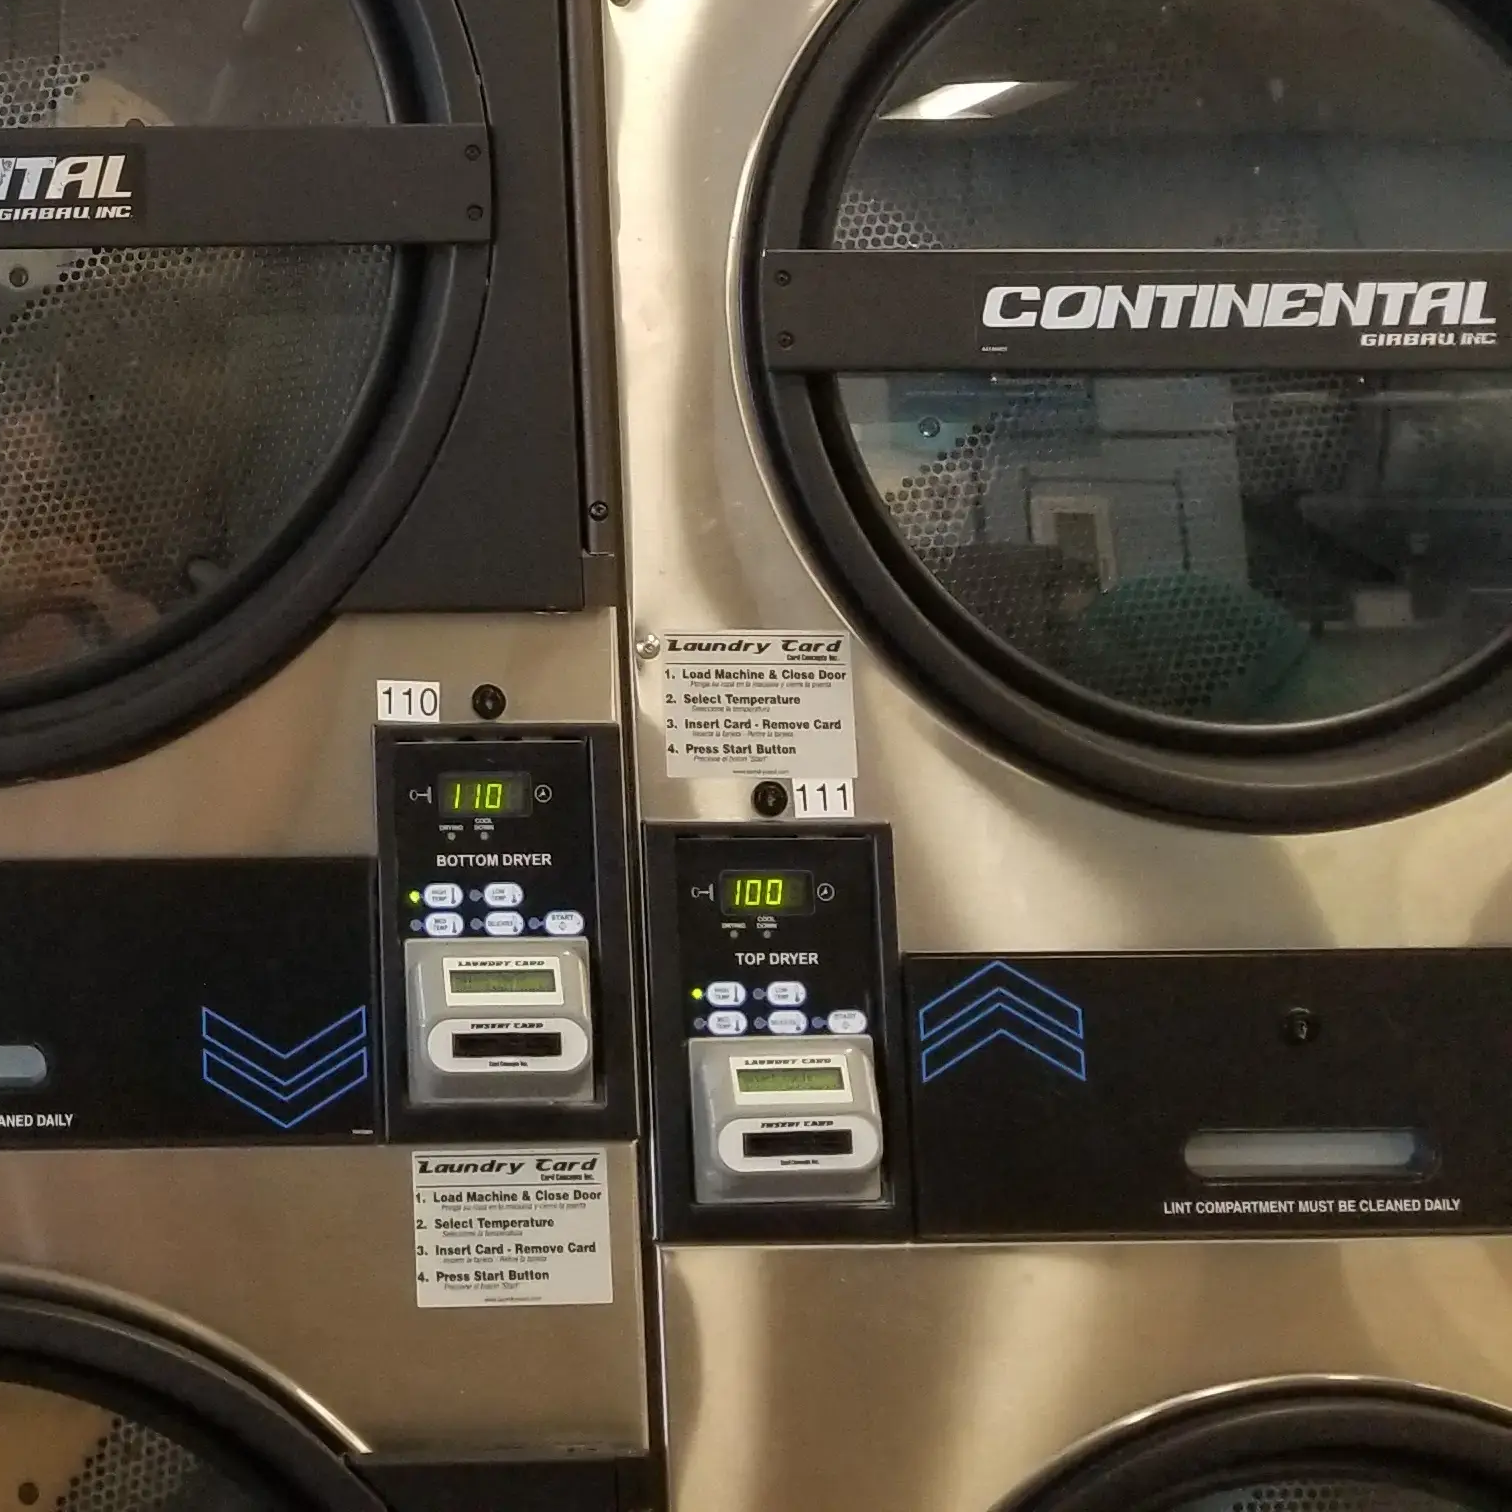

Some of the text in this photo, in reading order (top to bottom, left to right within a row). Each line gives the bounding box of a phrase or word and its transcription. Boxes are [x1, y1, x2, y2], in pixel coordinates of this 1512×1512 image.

[982, 281, 1496, 329] CONTINENTAL
[668, 639, 841, 654] Laundry Card
[682, 670, 711, 679] Load
[715, 670, 764, 679] Machine
[769, 670, 777, 679] &
[782, 670, 814, 679] Close
[819, 670, 846, 680] Door
[383, 686, 438, 716] 110
[684, 694, 721, 704] Select
[725, 694, 800, 705] Temperature
[685, 719, 719, 729] Insert
[724, 719, 751, 729] Card
[763, 720, 809, 729] Remove
[814, 720, 841, 729] Card
[686, 744, 719, 754] Press
[723, 744, 752, 754] Start
[757, 744, 796, 754] Button
[454, 784, 502, 809] 110
[796, 783, 847, 811] 111
[437, 854, 552, 866] BOTTOM DRYER
[735, 879, 783, 905] 100
[735, 952, 819, 965] TOP DRYER
[37, 1114, 74, 1127] DAILY
[418, 1158, 597, 1175] Laundry Card
[433, 1192, 462, 1202] Load
[467, 1192, 517, 1202] Machine
[522, 1192, 530, 1201] &
[536, 1191, 569, 1200] Close
[574, 1190, 601, 1200] Door
[1164, 1198, 1460, 1214] LINT COMPARTMENT MUST BE CLEANED DAILY
[434, 1219, 473, 1229] Select
[477, 1218, 554, 1229] Temperature
[436, 1246, 470, 1255] Insert
[475, 1244, 503, 1254] Card
[515, 1244, 563, 1253] Remove
[568, 1242, 595, 1253] Card
[436, 1272, 470, 1281] Press
[474, 1271, 504, 1281] Start
[509, 1270, 549, 1280] Button
